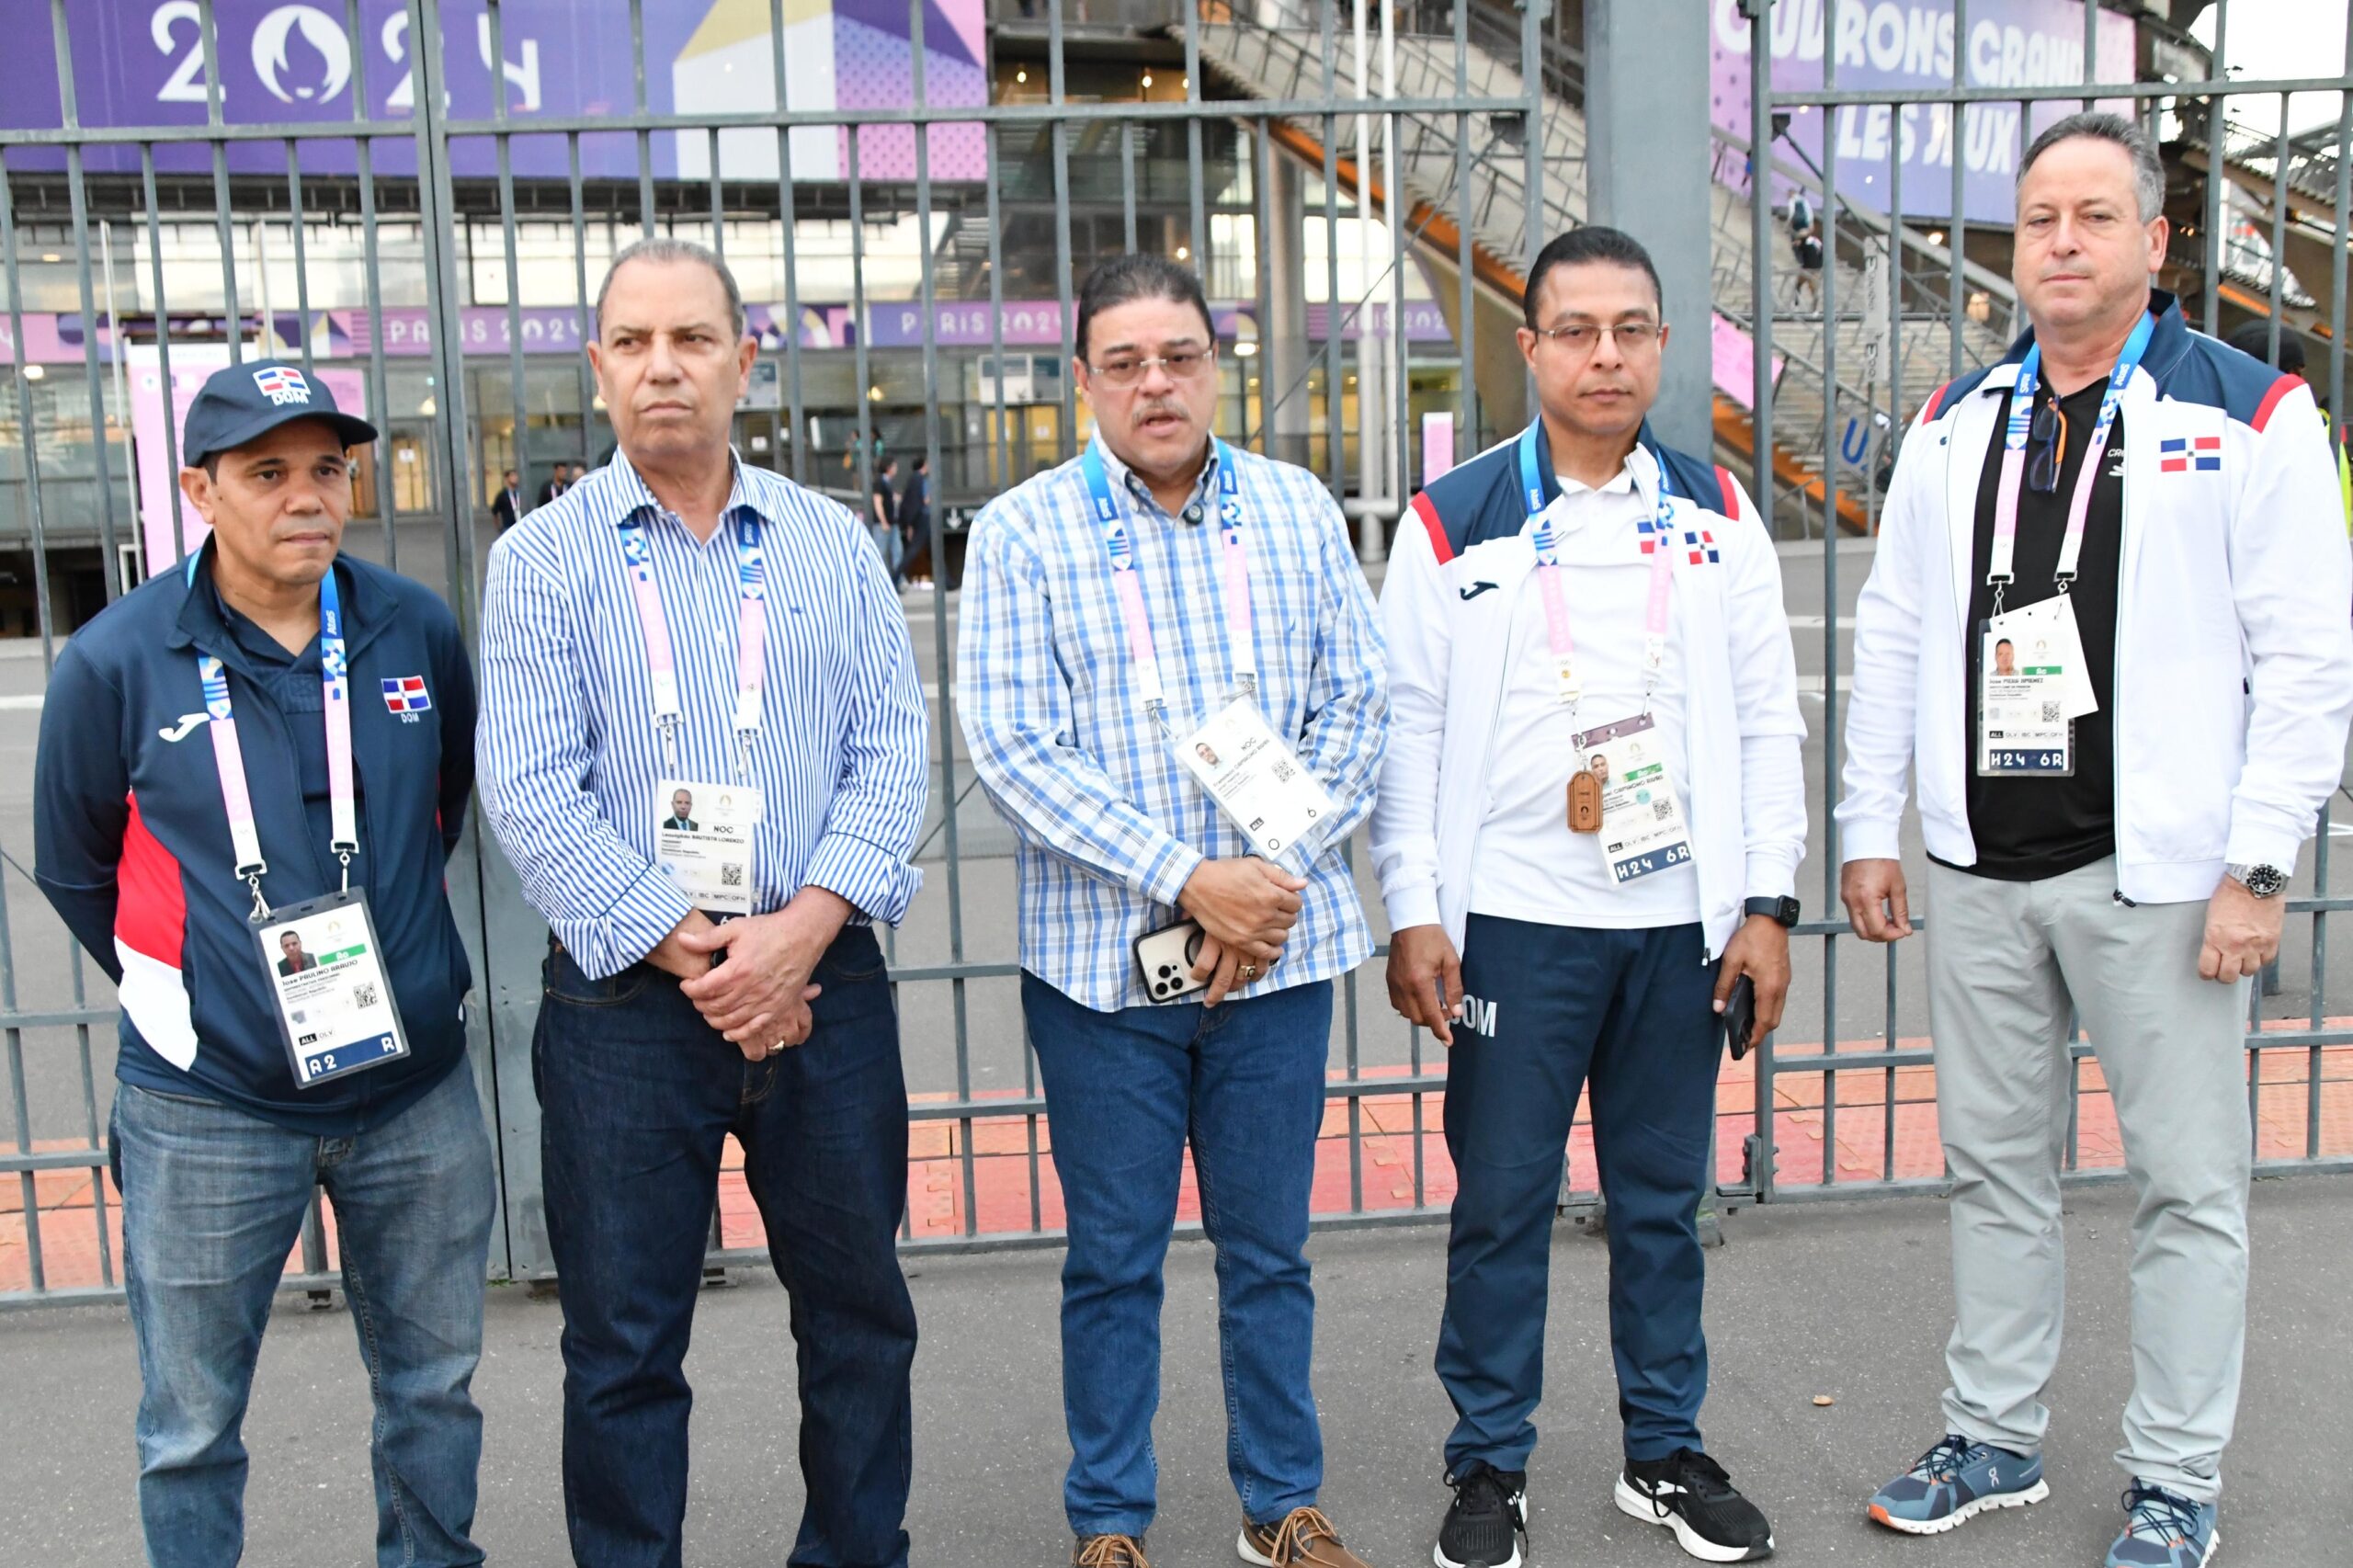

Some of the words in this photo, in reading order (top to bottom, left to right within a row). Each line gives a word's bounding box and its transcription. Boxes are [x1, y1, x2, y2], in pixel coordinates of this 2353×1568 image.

[390, 319, 488, 344] PAIS
[902, 312, 985, 335] PRIS
[270, 392, 310, 406] DOM
[401, 712, 420, 723] DOM
[713, 825, 734, 835] NOC
[299, 968, 330, 983] PAULINO
[330, 959, 358, 972] ARAUJO
[1449, 994, 1497, 1038] OM
[301, 1035, 315, 1045] ALL
[381, 1036, 396, 1052] R
